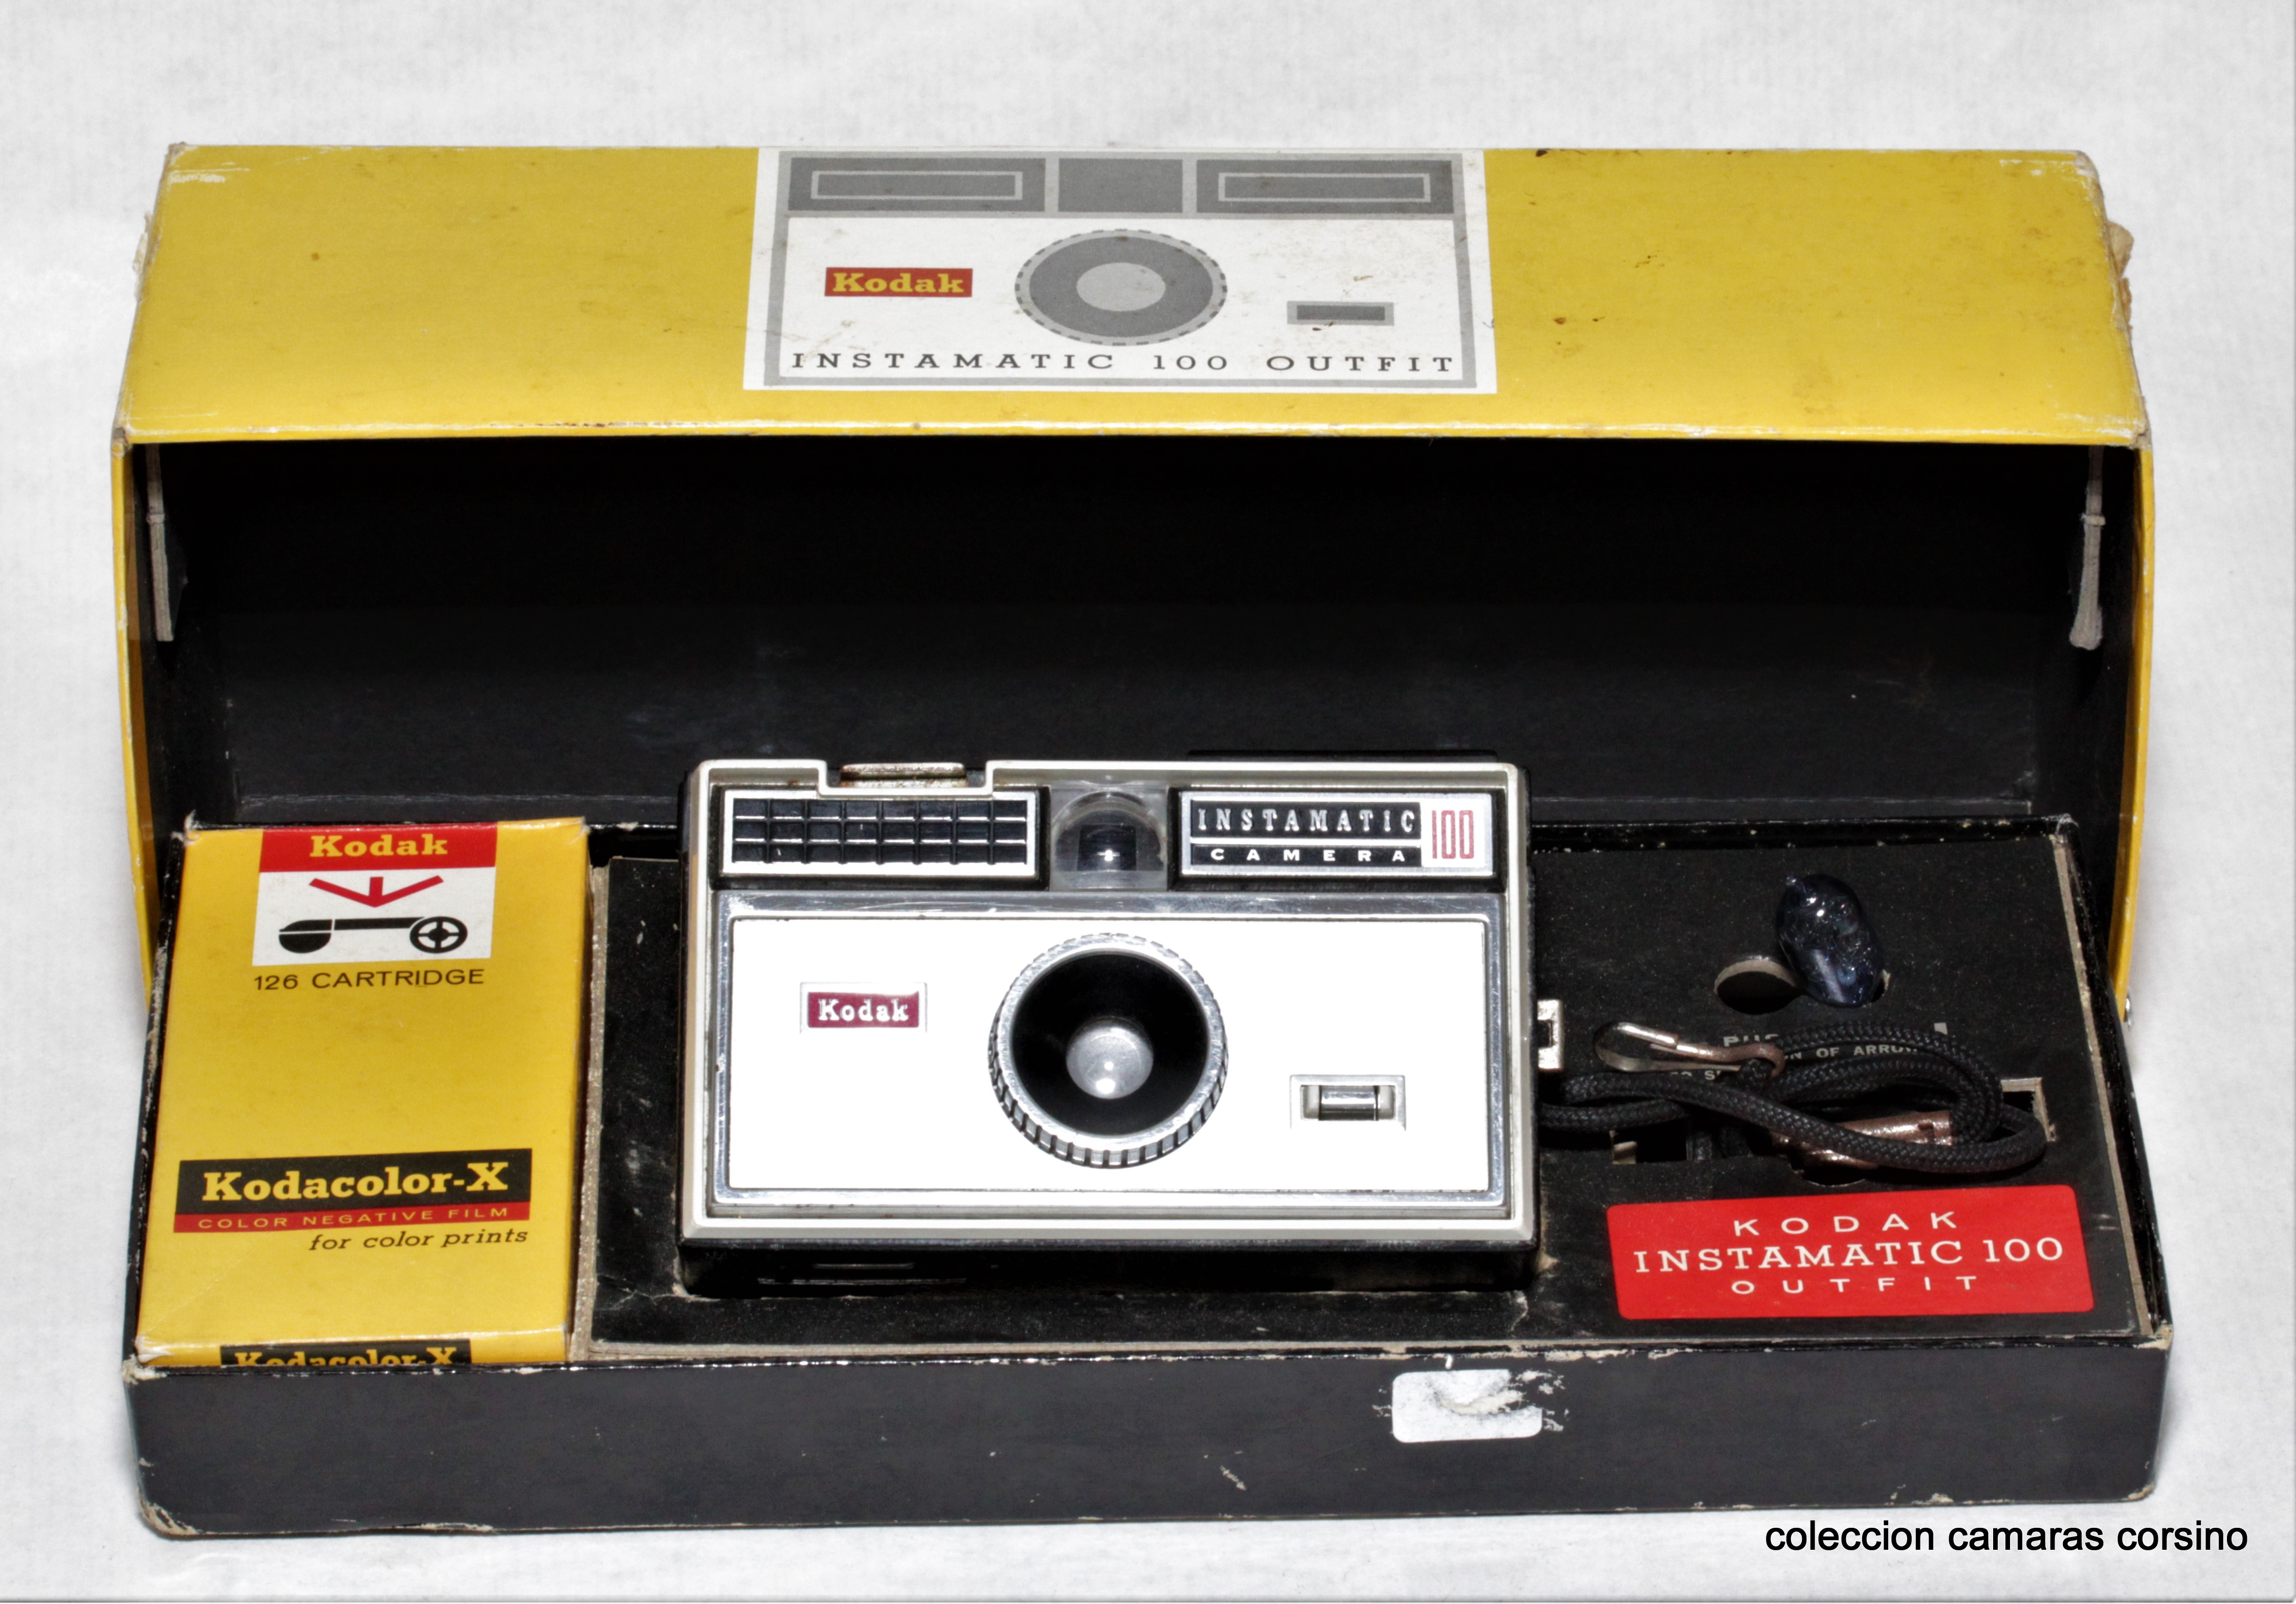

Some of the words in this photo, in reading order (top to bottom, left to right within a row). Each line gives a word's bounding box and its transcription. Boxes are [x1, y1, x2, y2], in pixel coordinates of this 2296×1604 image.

[832, 272, 964, 293] Kodak
[792, 353, 1113, 369] INSTAMATIC
[1154, 355, 1228, 370] 100
[1266, 356, 1453, 372] OUTFIT
[1198, 808, 1415, 832] INSTAMATIC
[1432, 810, 1474, 859] 100
[310, 834, 448, 858] Kodak
[1210, 849, 1405, 862] CAMERA
[254, 974, 299, 991] 126
[312, 968, 485, 989] CARTRIDGE
[818, 998, 909, 1022] Kodak
[1816, 1047, 1840, 1058] OF
[202, 1162, 509, 1201] Kodacolor-X
[197, 1217, 288, 1230] COLOR
[302, 1210, 434, 1226] NEGATIVE
[448, 1207, 508, 1219] FILM
[1733, 1211, 1957, 1237] KODAK
[308, 1233, 351, 1252] for
[363, 1230, 434, 1249] color
[441, 1228, 528, 1249] prints
[1633, 1240, 1963, 1274] INSTAMATIC
[1982, 1237, 2064, 1263] 100
[1730, 1275, 1978, 1295] OUTFIT
